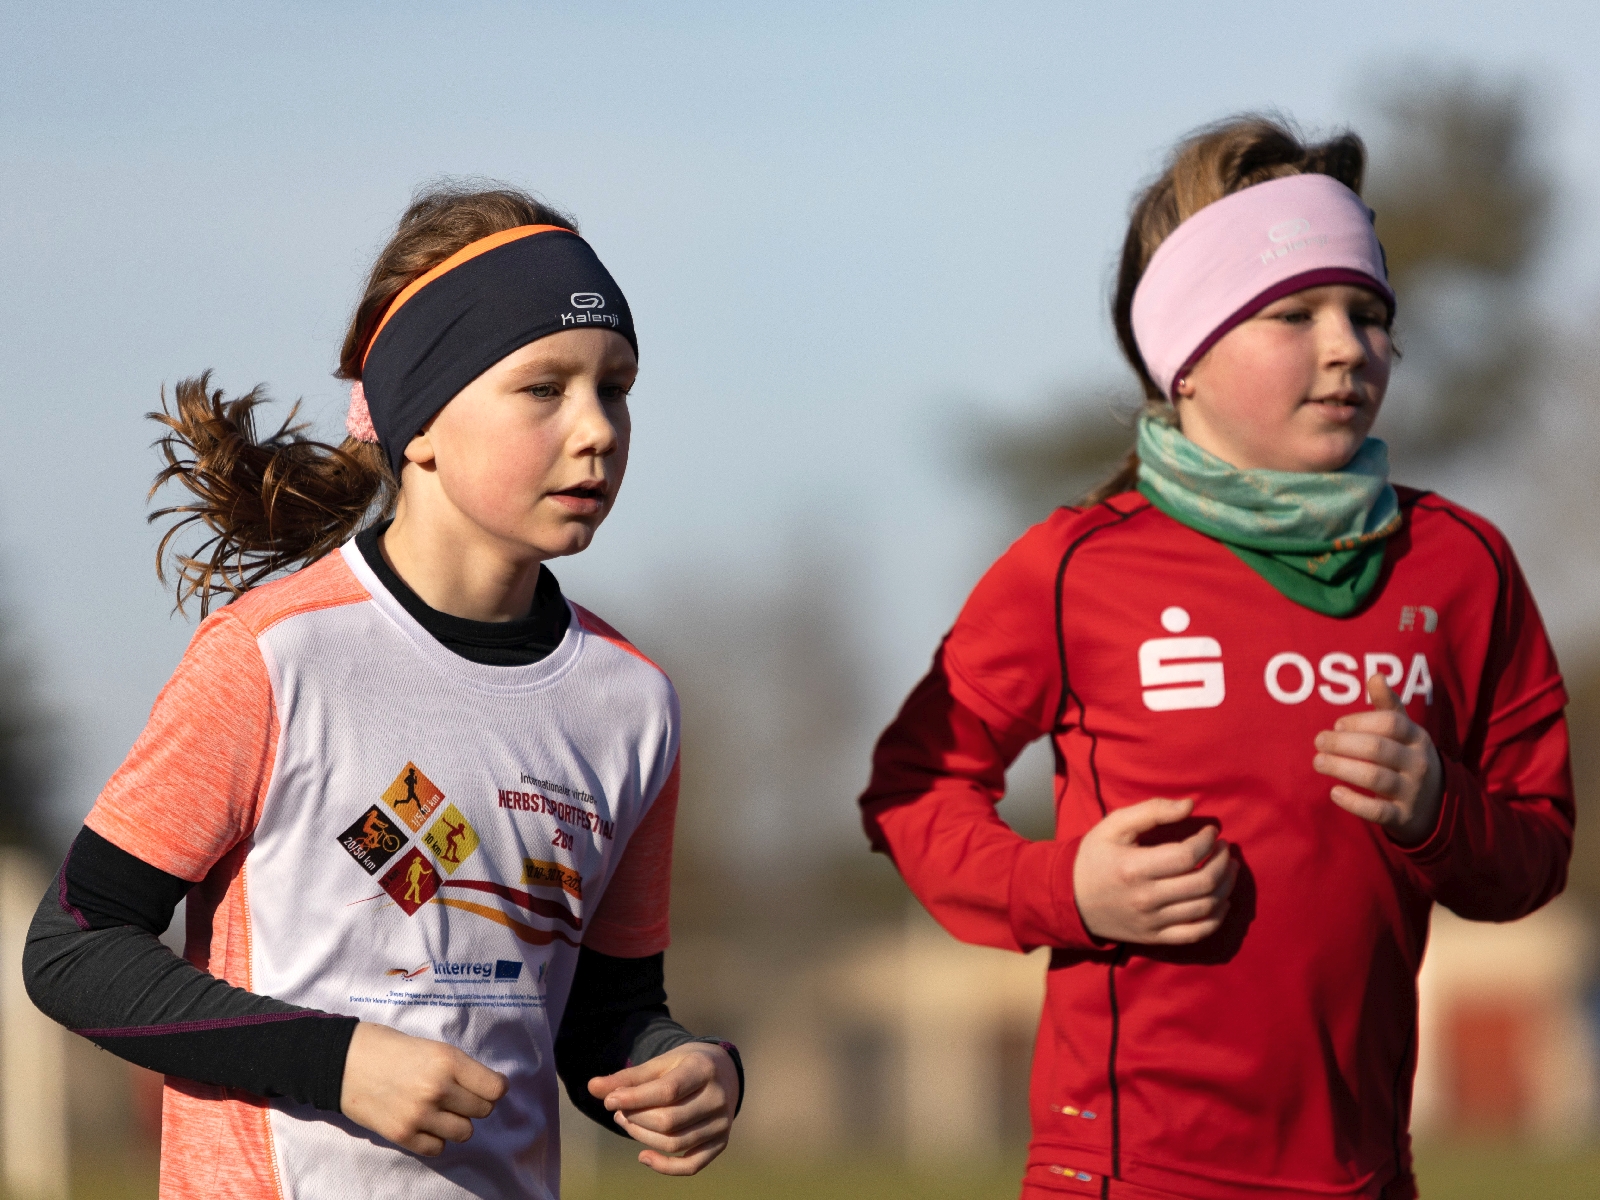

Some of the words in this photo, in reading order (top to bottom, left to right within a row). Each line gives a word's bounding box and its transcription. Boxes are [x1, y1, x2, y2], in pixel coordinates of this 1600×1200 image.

[561, 310, 619, 327] Kalenji
[1263, 651, 1433, 705] OSPA
[362, 855, 376, 871] km
[433, 960, 493, 977] Interreg
